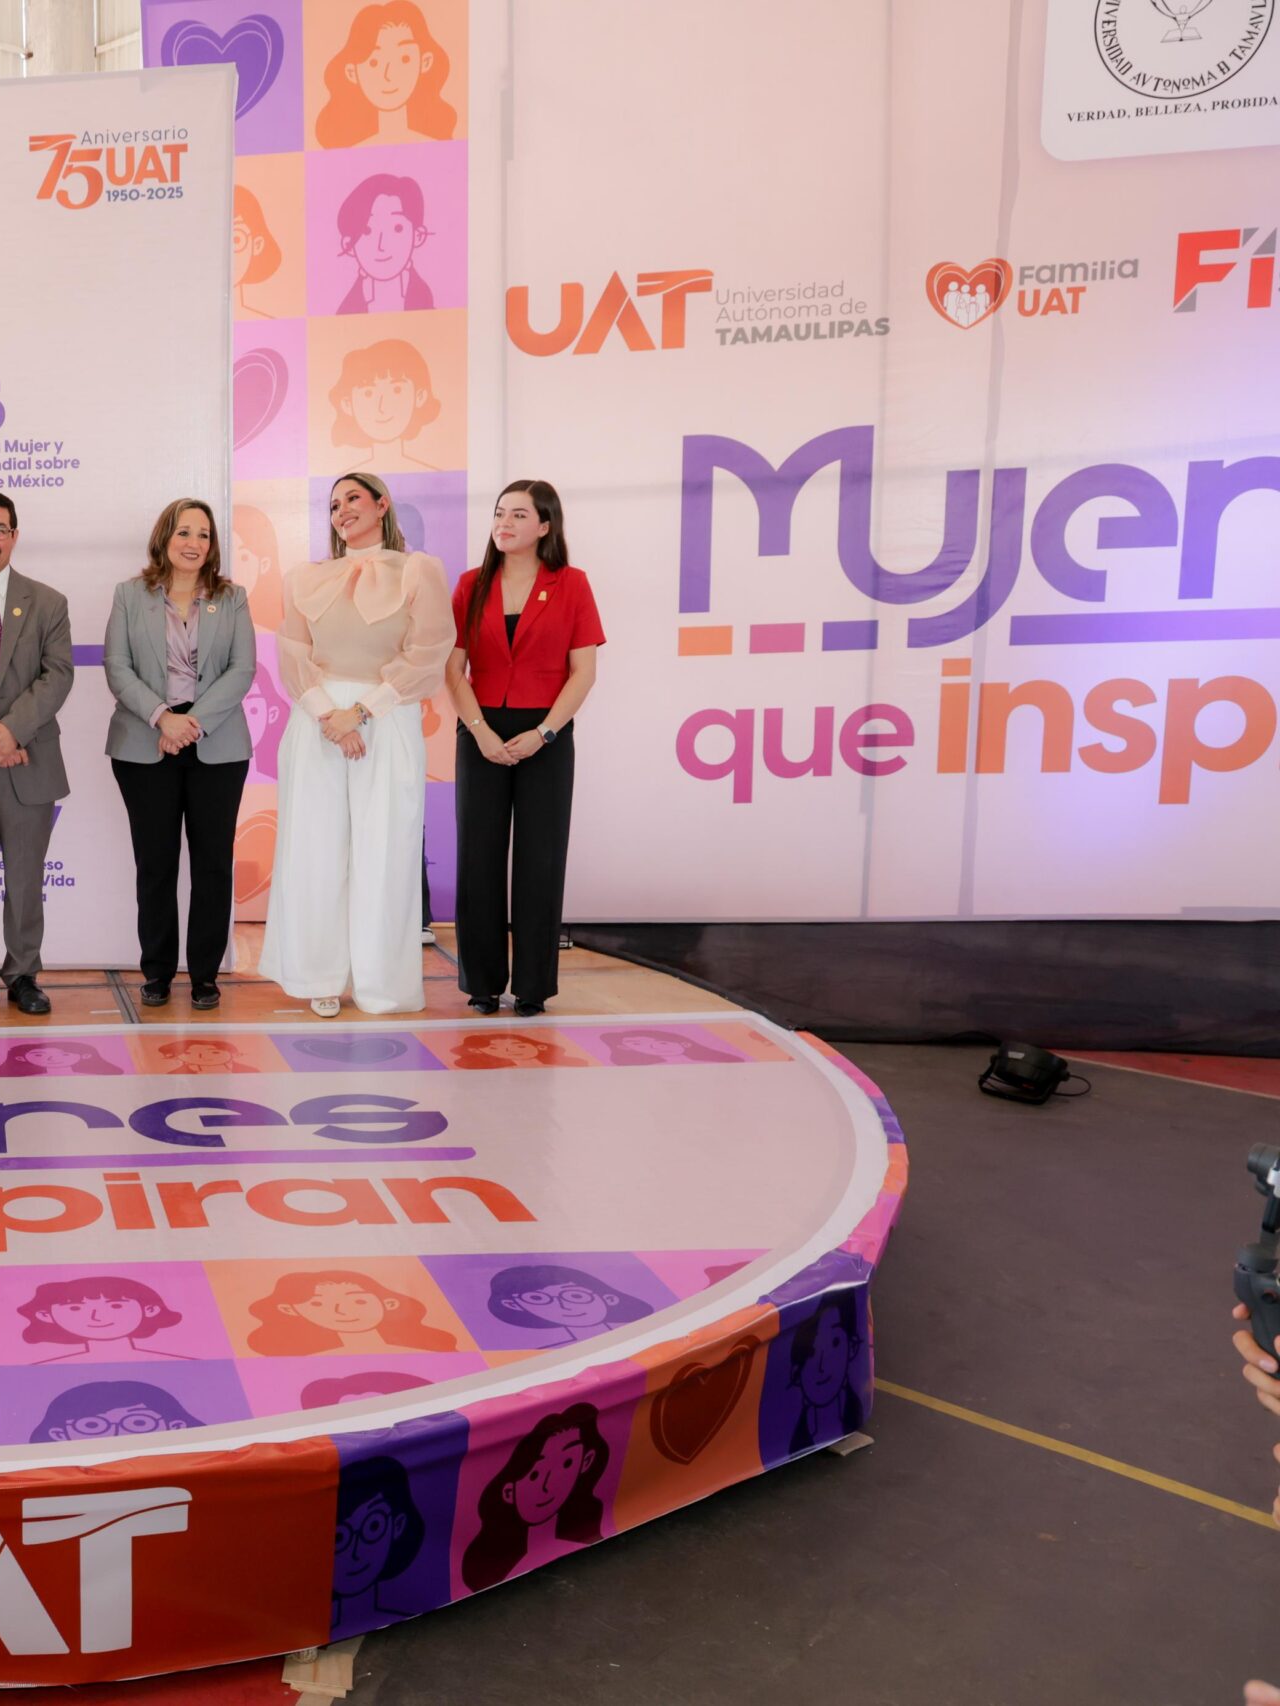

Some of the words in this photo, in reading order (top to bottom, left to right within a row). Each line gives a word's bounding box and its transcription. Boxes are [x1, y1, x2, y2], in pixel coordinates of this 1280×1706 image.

[1102, 0, 1133, 75] IVERSIDAD
[1229, 0, 1267, 60] TAMAVL
[1067, 108, 1130, 122] VERDAD,
[1135, 103, 1207, 117] BELLEZA,
[1212, 96, 1280, 111] PROBIDA
[81, 125, 188, 145] Aniversario
[29, 134, 104, 210] 75
[106, 143, 189, 186] UAT
[105, 186, 184, 202] 1950-2025
[1018, 258, 1139, 286] Familia
[715, 280, 845, 306] Universidad
[1017, 286, 1087, 317] UAT
[506, 270, 714, 357] UAT
[715, 301, 832, 324] Autónoma
[839, 298, 867, 315] de
[715, 317, 891, 346] TAMAULIPAS
[4, 439, 51, 455] Mujer
[54, 441, 64, 455] y
[35, 456, 80, 470] sobre
[8, 473, 65, 488] México
[679, 425, 1280, 649] Mujer
[675, 703, 915, 804] que
[936, 658, 1280, 805] insp
